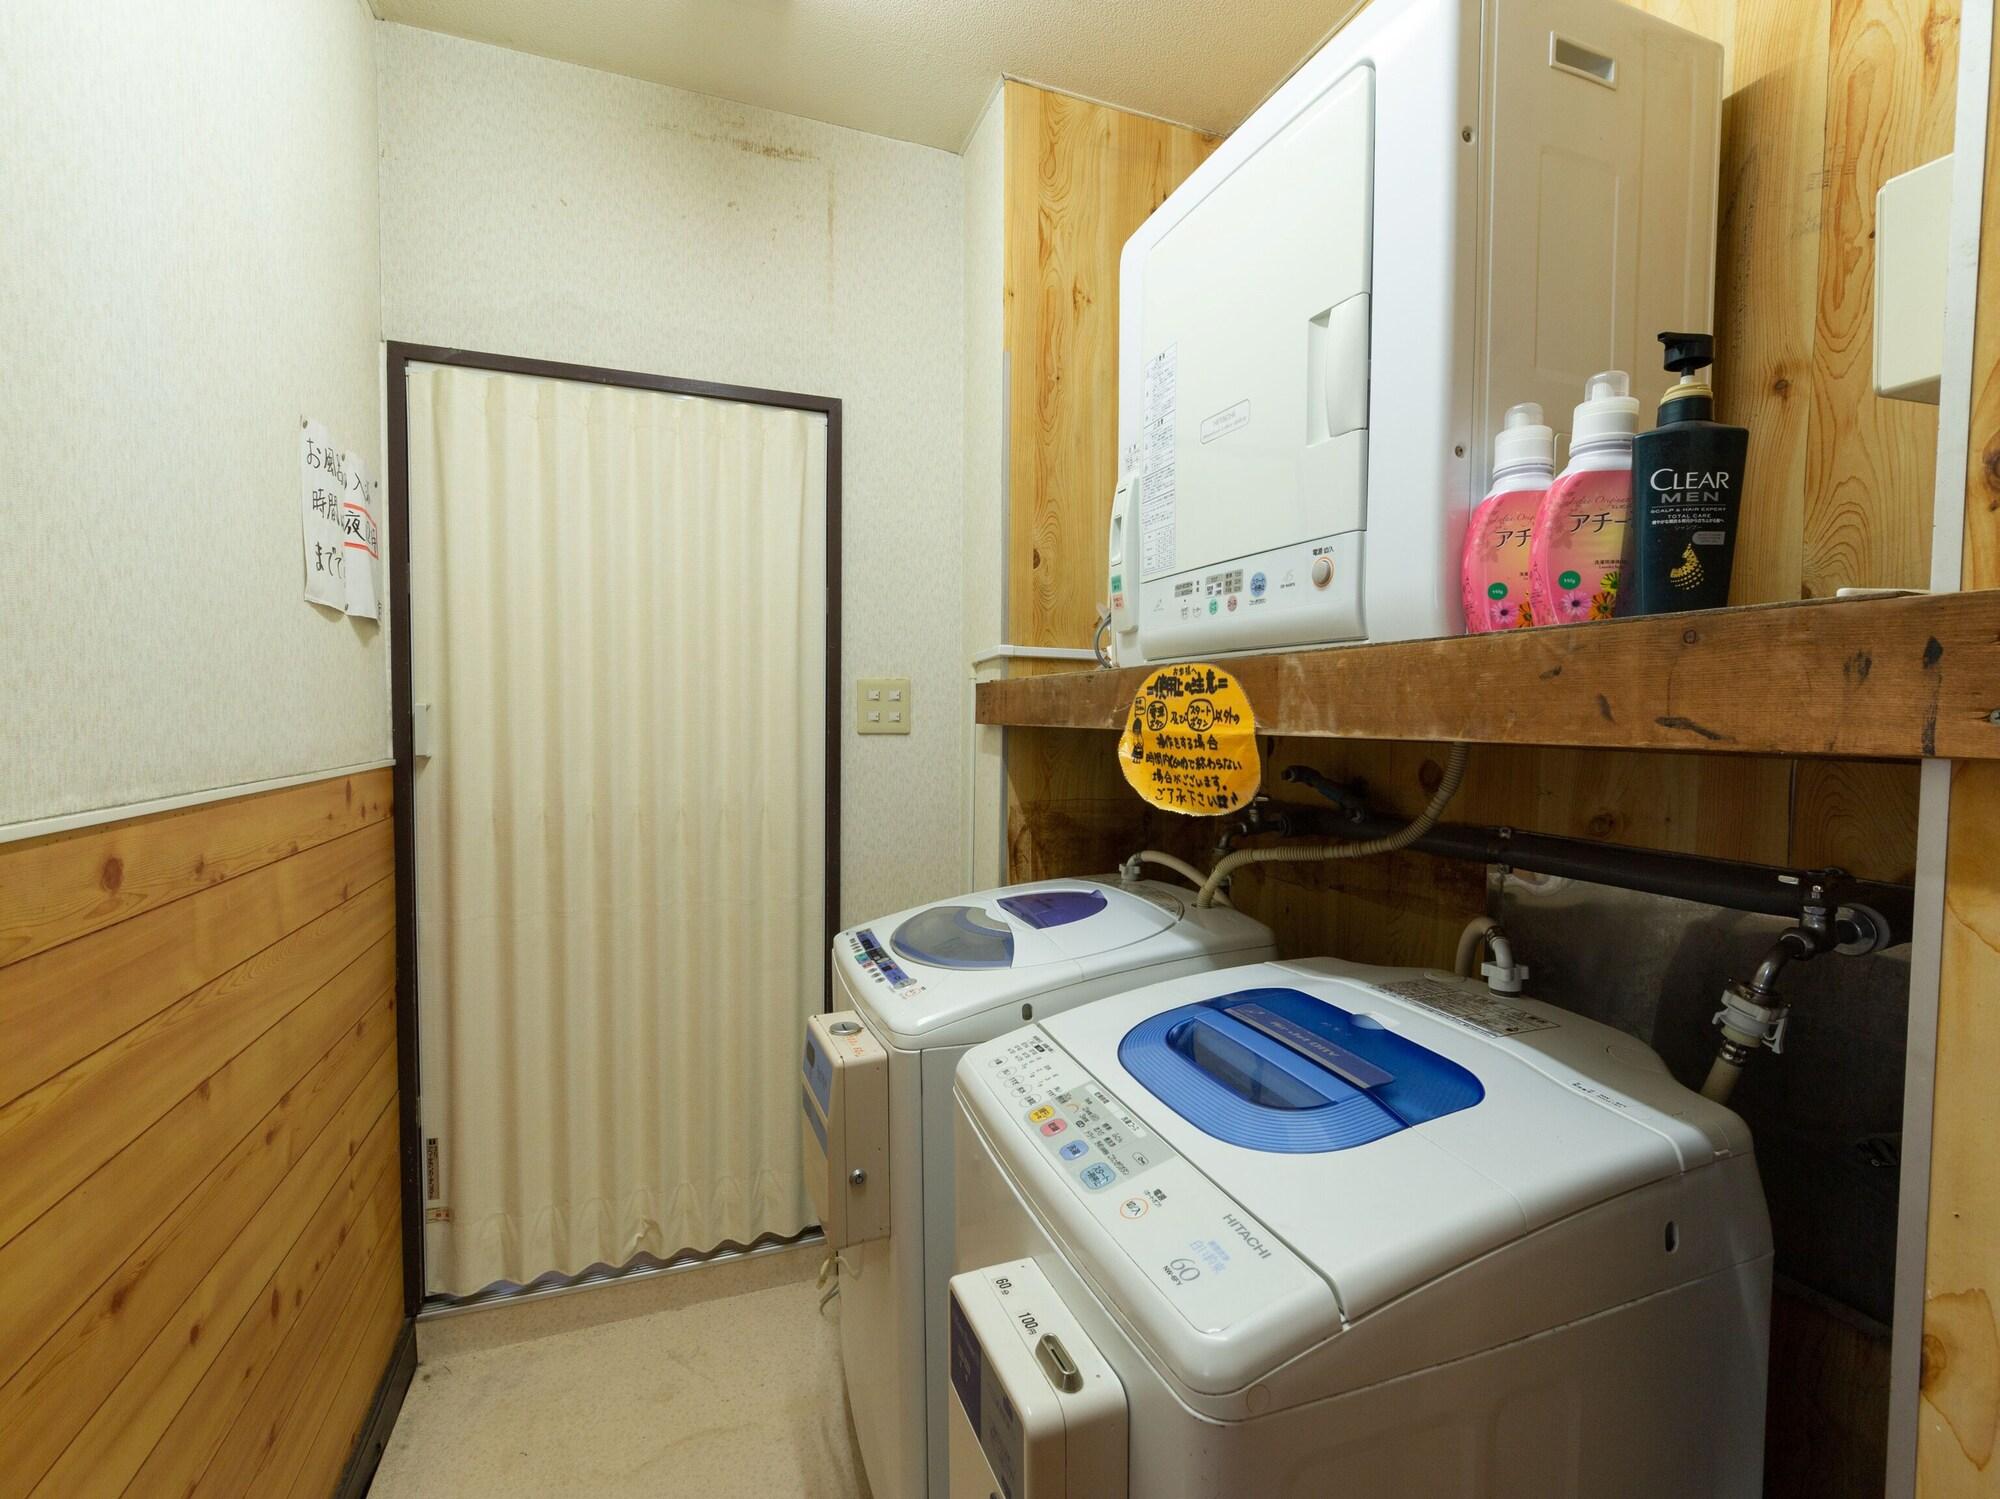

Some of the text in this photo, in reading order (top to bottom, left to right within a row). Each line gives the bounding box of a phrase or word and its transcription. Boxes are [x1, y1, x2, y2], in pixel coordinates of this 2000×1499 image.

[1650, 468, 1730, 491] CLEAR
[1661, 491, 1720, 503] MEN
[1222, 1213, 1272, 1260] HITACHI
[1170, 1258, 1200, 1281] 60
